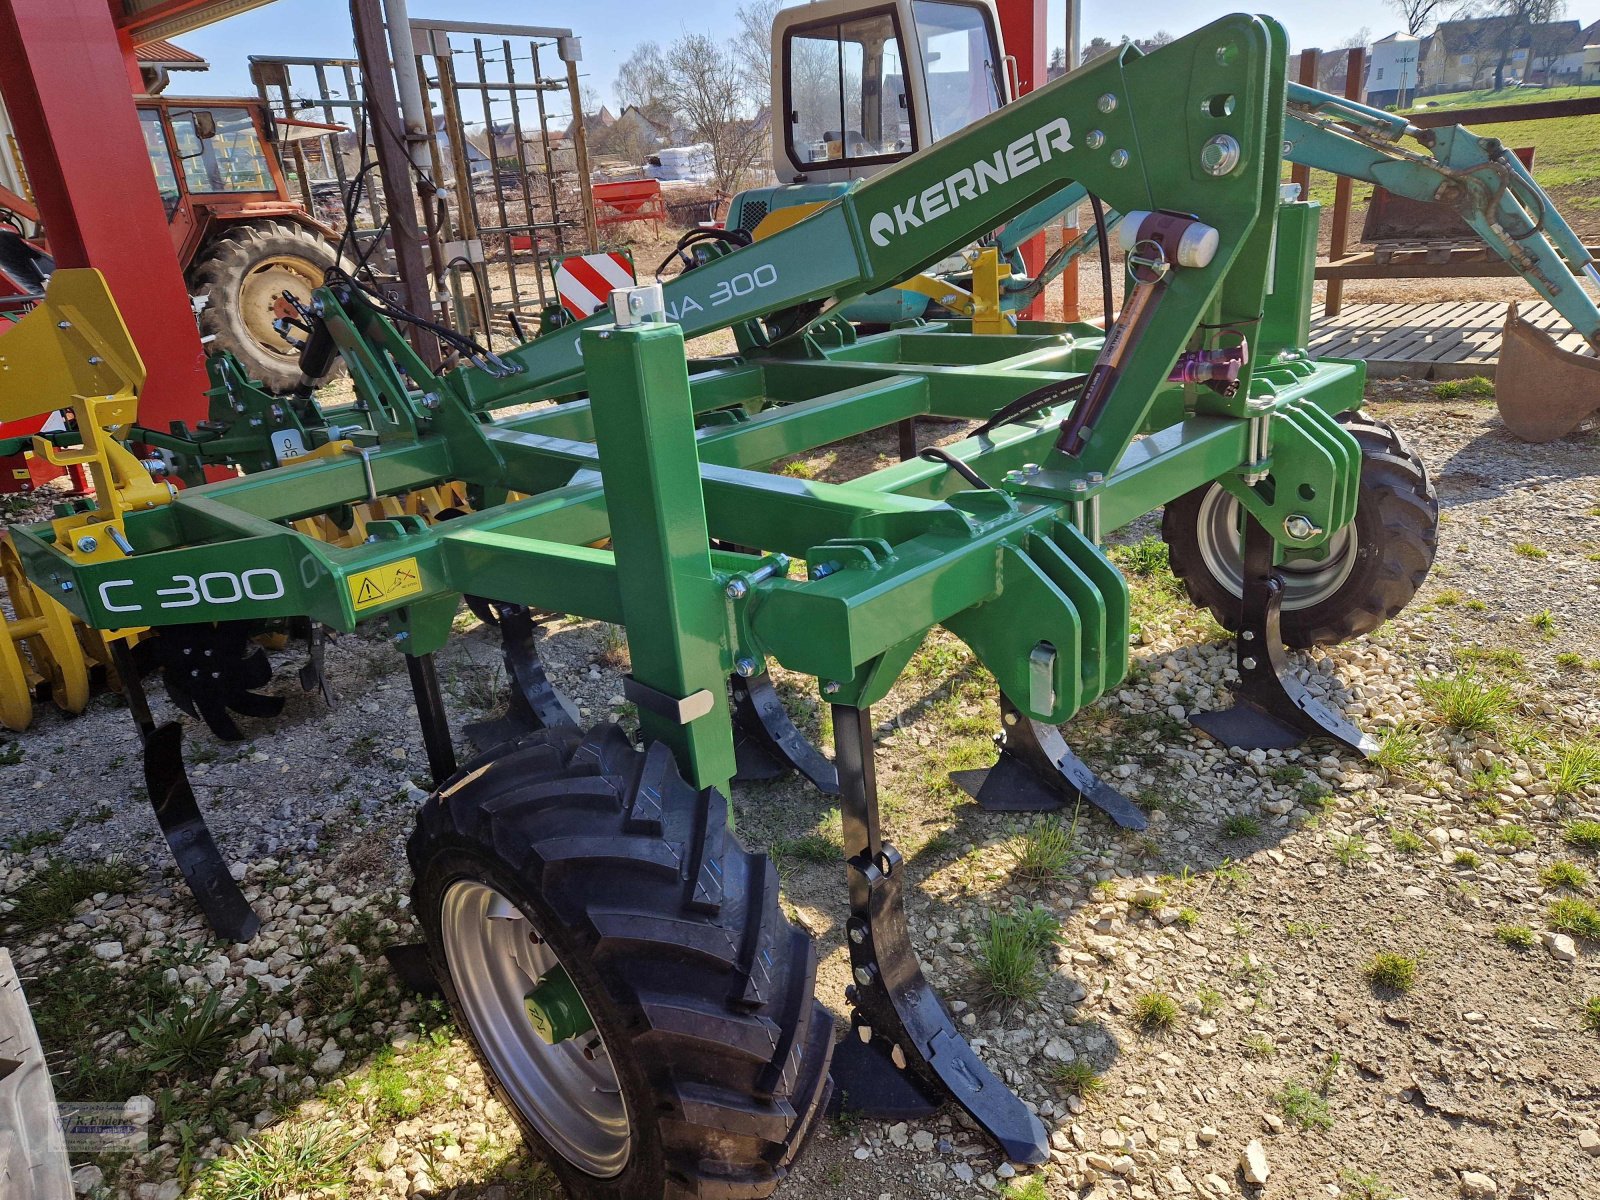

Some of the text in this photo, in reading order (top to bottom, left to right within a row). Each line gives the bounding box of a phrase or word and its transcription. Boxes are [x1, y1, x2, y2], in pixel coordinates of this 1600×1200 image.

[893, 117, 1074, 235] KERNER
[710, 263, 778, 307] 300
[283, 438, 292, 449] 0
[98, 579, 142, 612] C
[156, 568, 285, 608] 300
